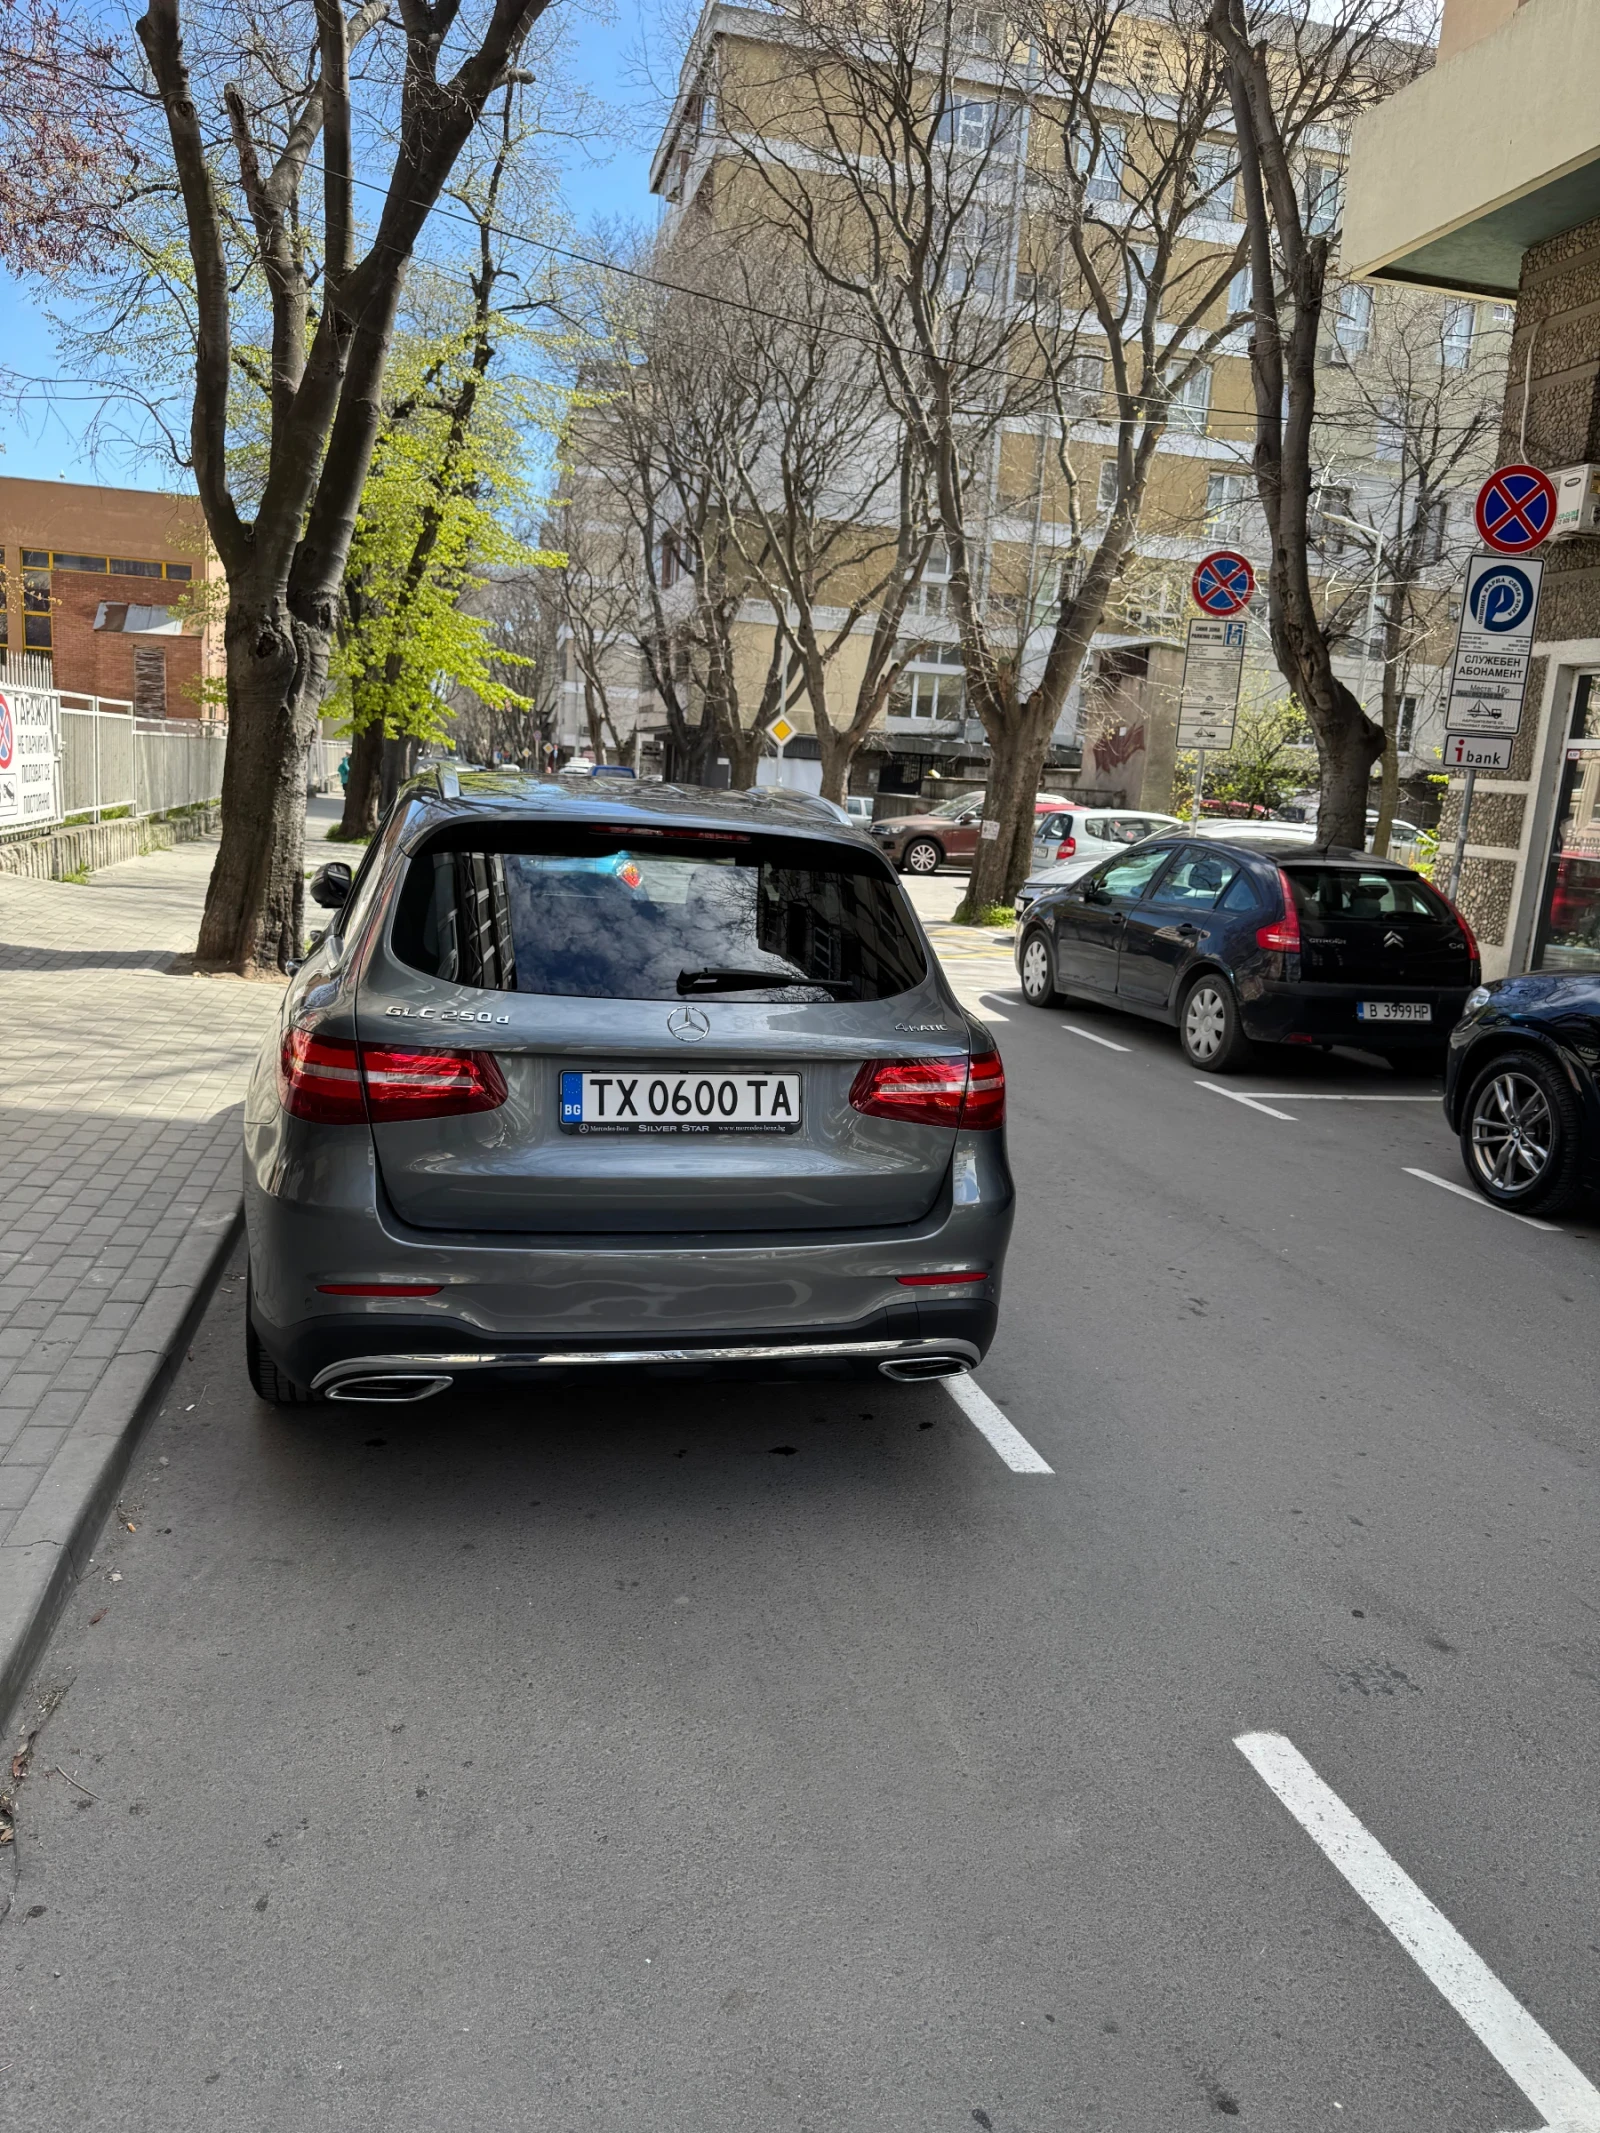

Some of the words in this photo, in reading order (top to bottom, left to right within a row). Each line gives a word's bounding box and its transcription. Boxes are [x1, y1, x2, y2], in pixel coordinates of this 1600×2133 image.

[1484, 578, 1505, 593] ВАРНА
[1508, 598, 1522, 616] ЗОНА
[1464, 654, 1521, 667] СЛУЖЕБЕН
[1458, 666, 1524, 678] АБОНАМЕНТ
[14, 697, 49, 725] ГАРАЖИ
[384, 1006, 436, 1020] GLC
[1384, 1004, 1412, 1018] 3999
[590, 1079, 639, 1116] TX
[648, 1080, 738, 1116] 0600
[747, 1080, 792, 1116] TA
[564, 1104, 582, 1116] BG
[718, 1125, 786, 1133] www.mercedes-benz.bg
